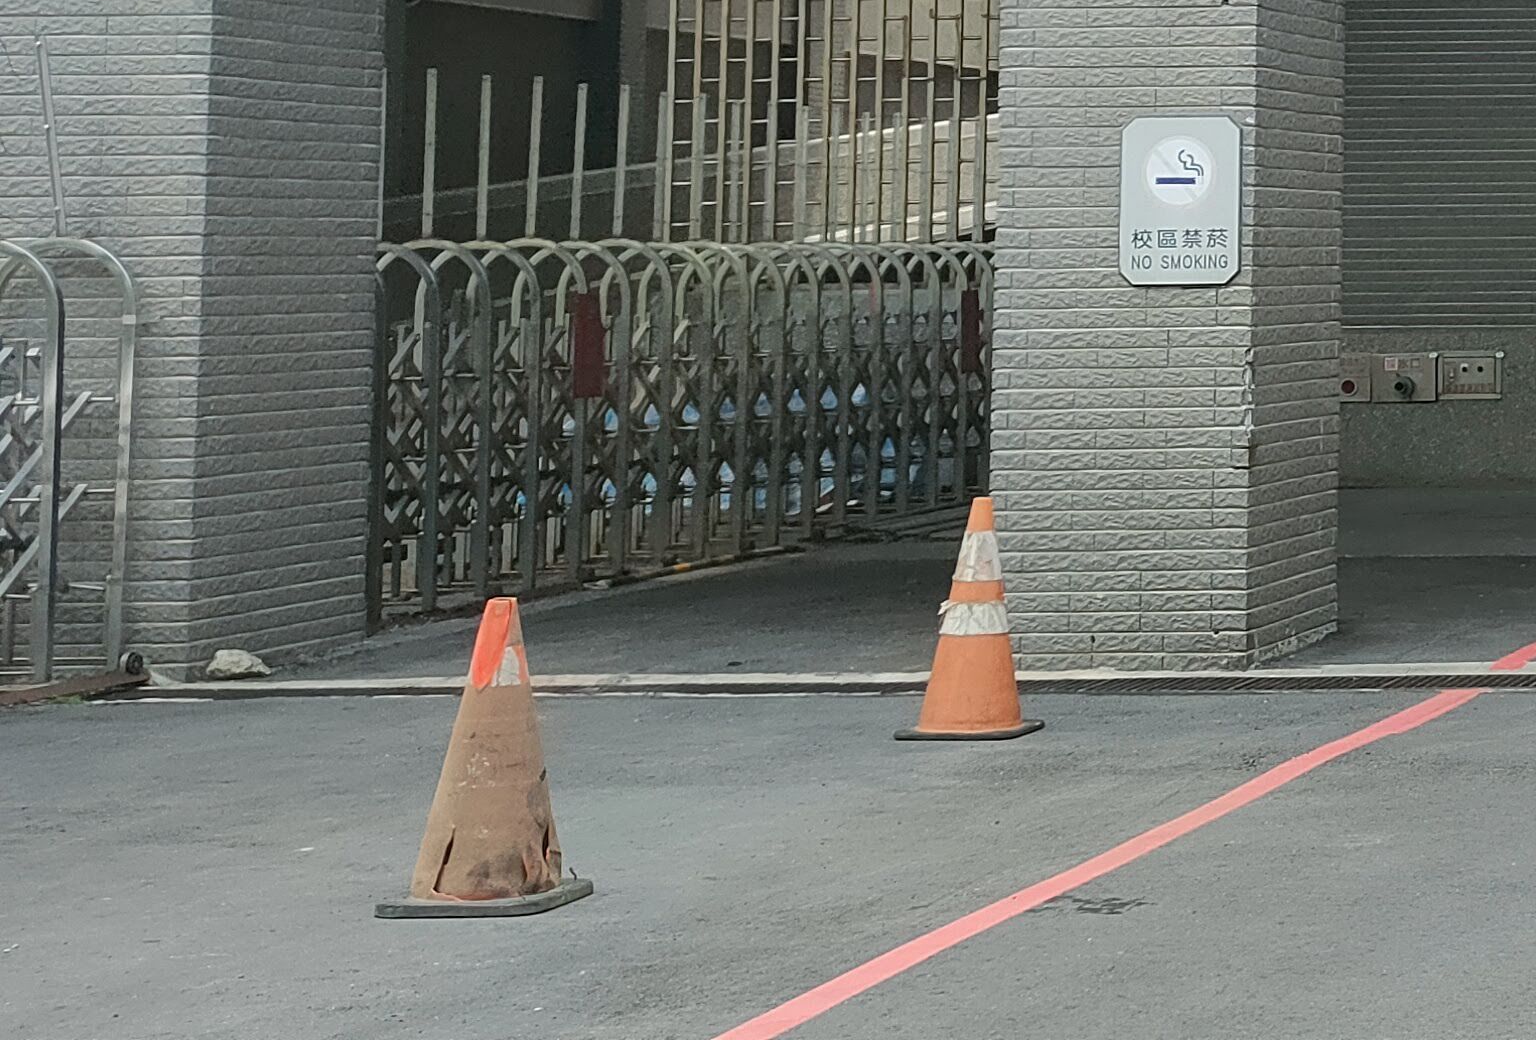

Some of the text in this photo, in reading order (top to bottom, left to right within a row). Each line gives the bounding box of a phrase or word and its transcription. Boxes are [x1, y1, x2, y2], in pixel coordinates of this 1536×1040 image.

[1131, 229, 1228, 249] 校區禁菸
[1131, 254, 1229, 270] NO SMOKING
